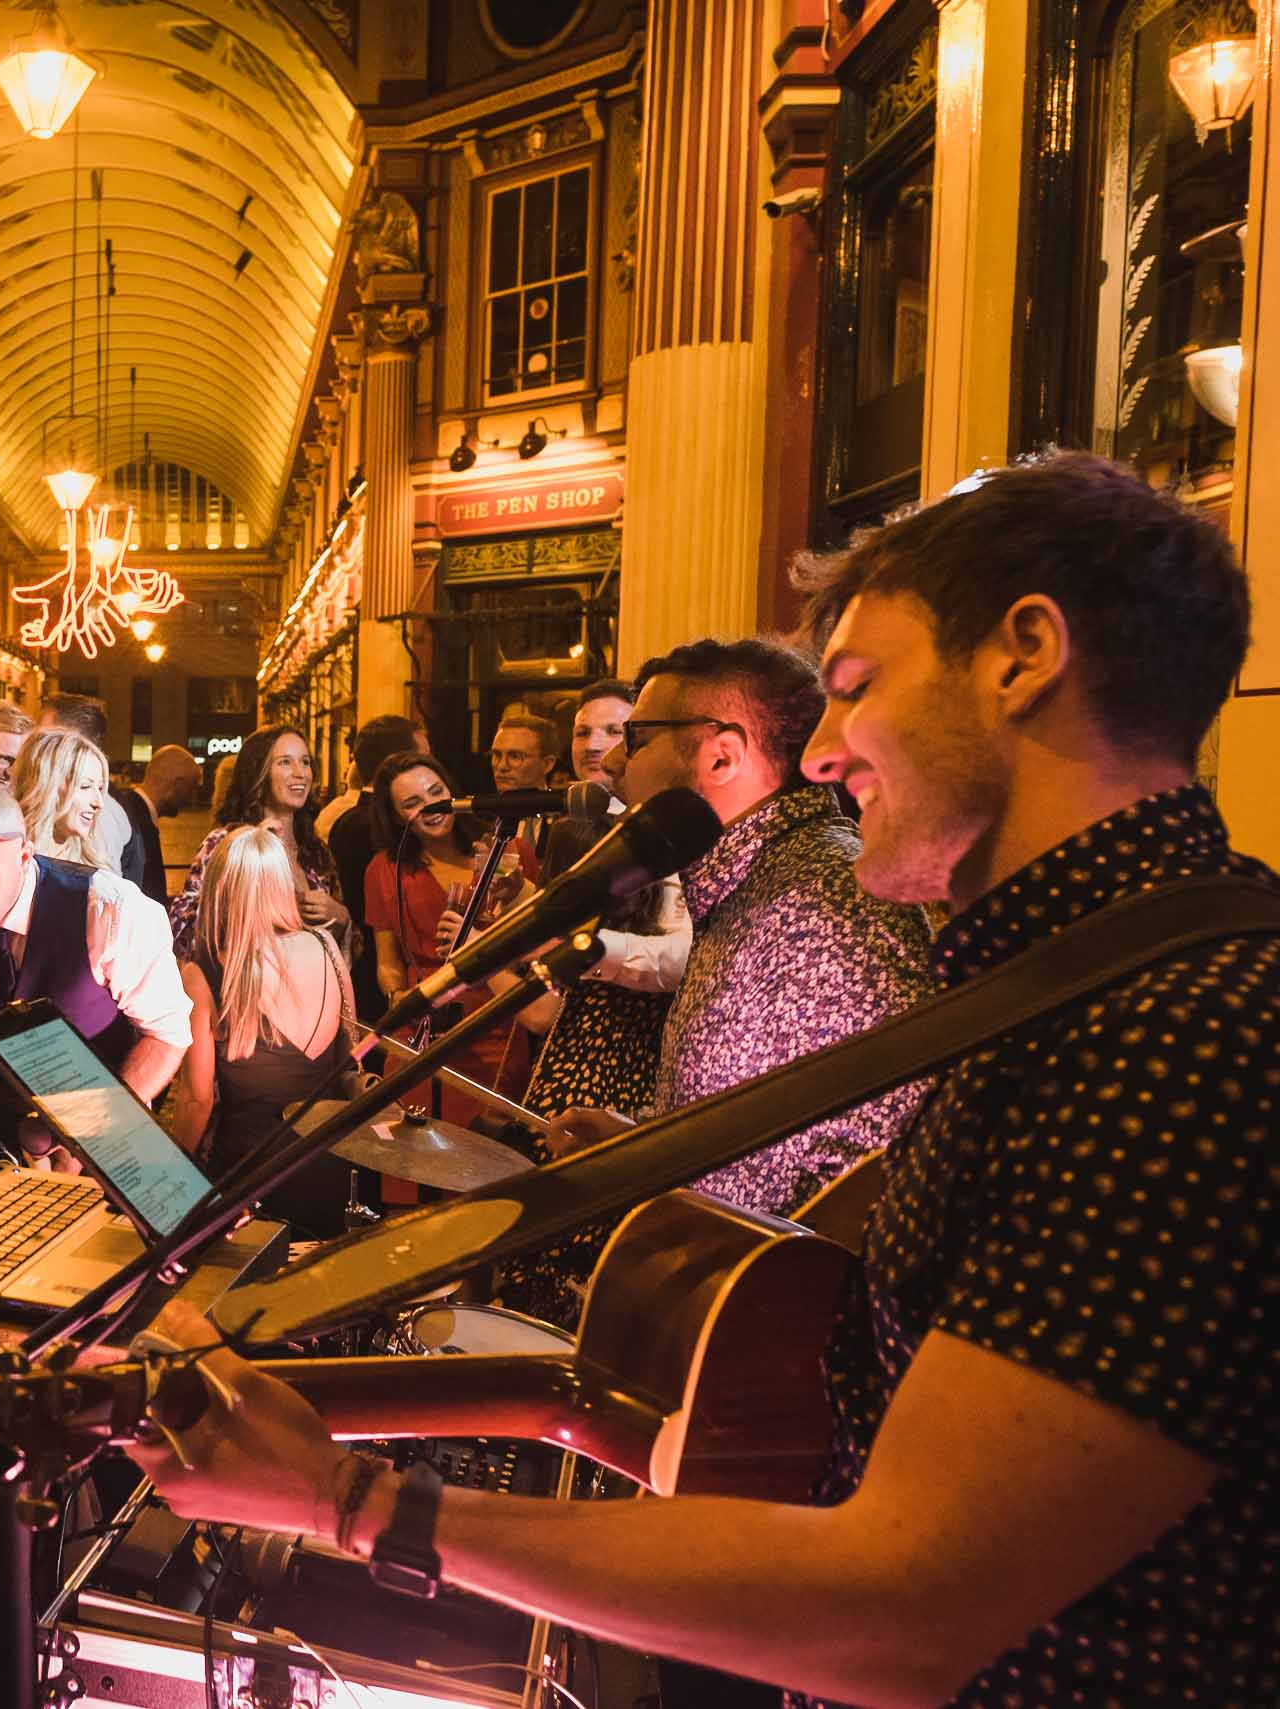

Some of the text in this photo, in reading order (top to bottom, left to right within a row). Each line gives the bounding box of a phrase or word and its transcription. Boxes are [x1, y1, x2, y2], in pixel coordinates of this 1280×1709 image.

[452, 487, 606, 521] THE PEN SHOP
[207, 735, 242, 756] pod
